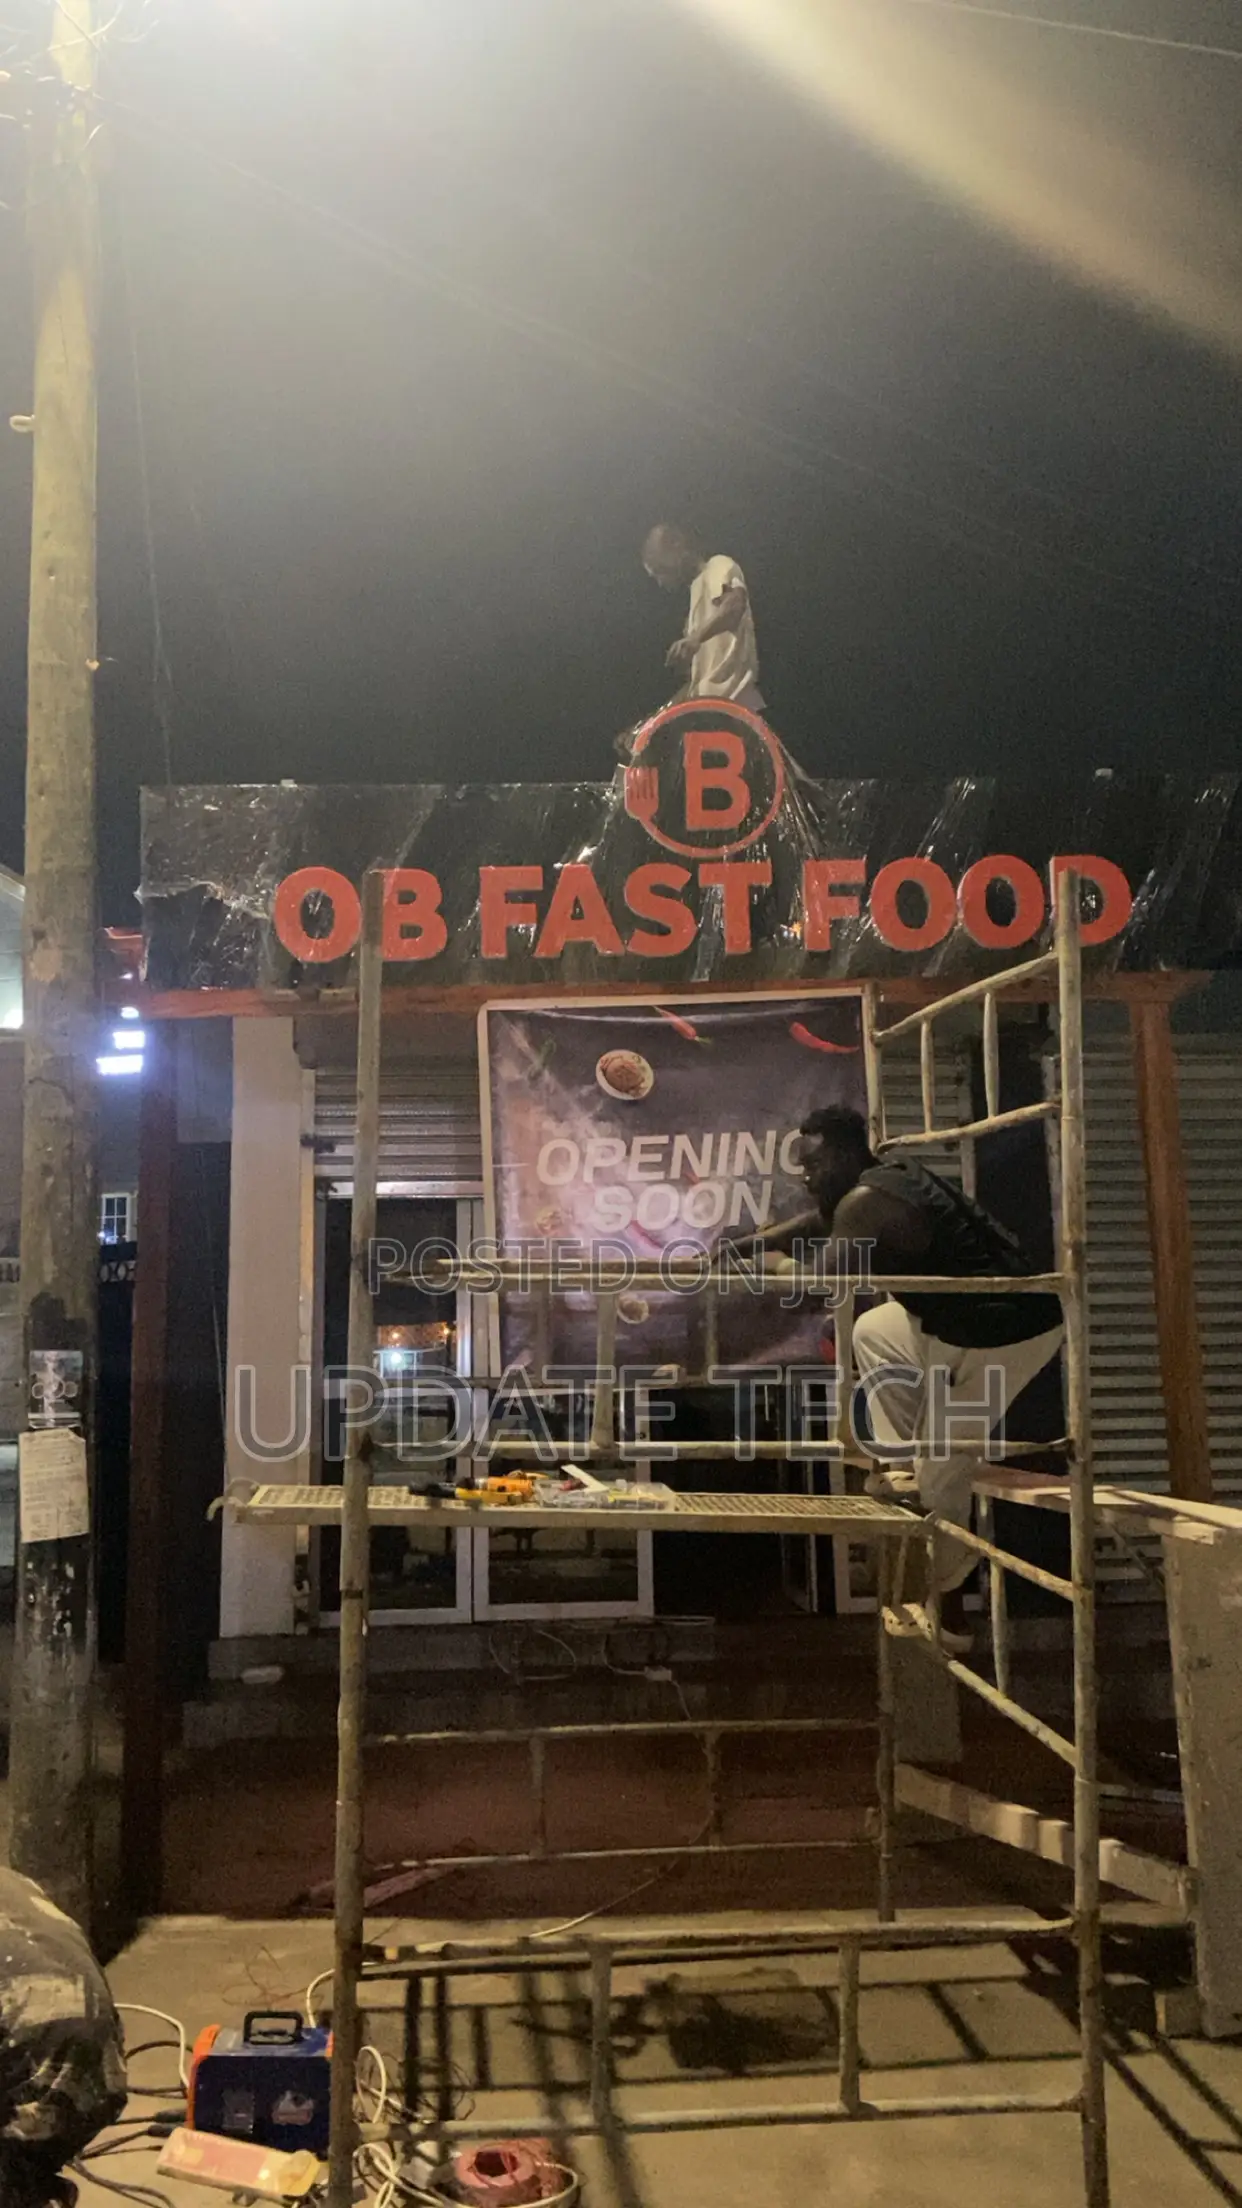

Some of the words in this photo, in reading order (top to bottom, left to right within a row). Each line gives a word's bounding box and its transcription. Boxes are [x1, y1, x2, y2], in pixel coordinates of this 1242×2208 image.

[683, 730, 752, 831] B
[274, 866, 448, 963] OB
[480, 860, 772, 960] FAST
[803, 854, 1133, 952] FOOD
[593, 1180, 773, 1233] SOON
